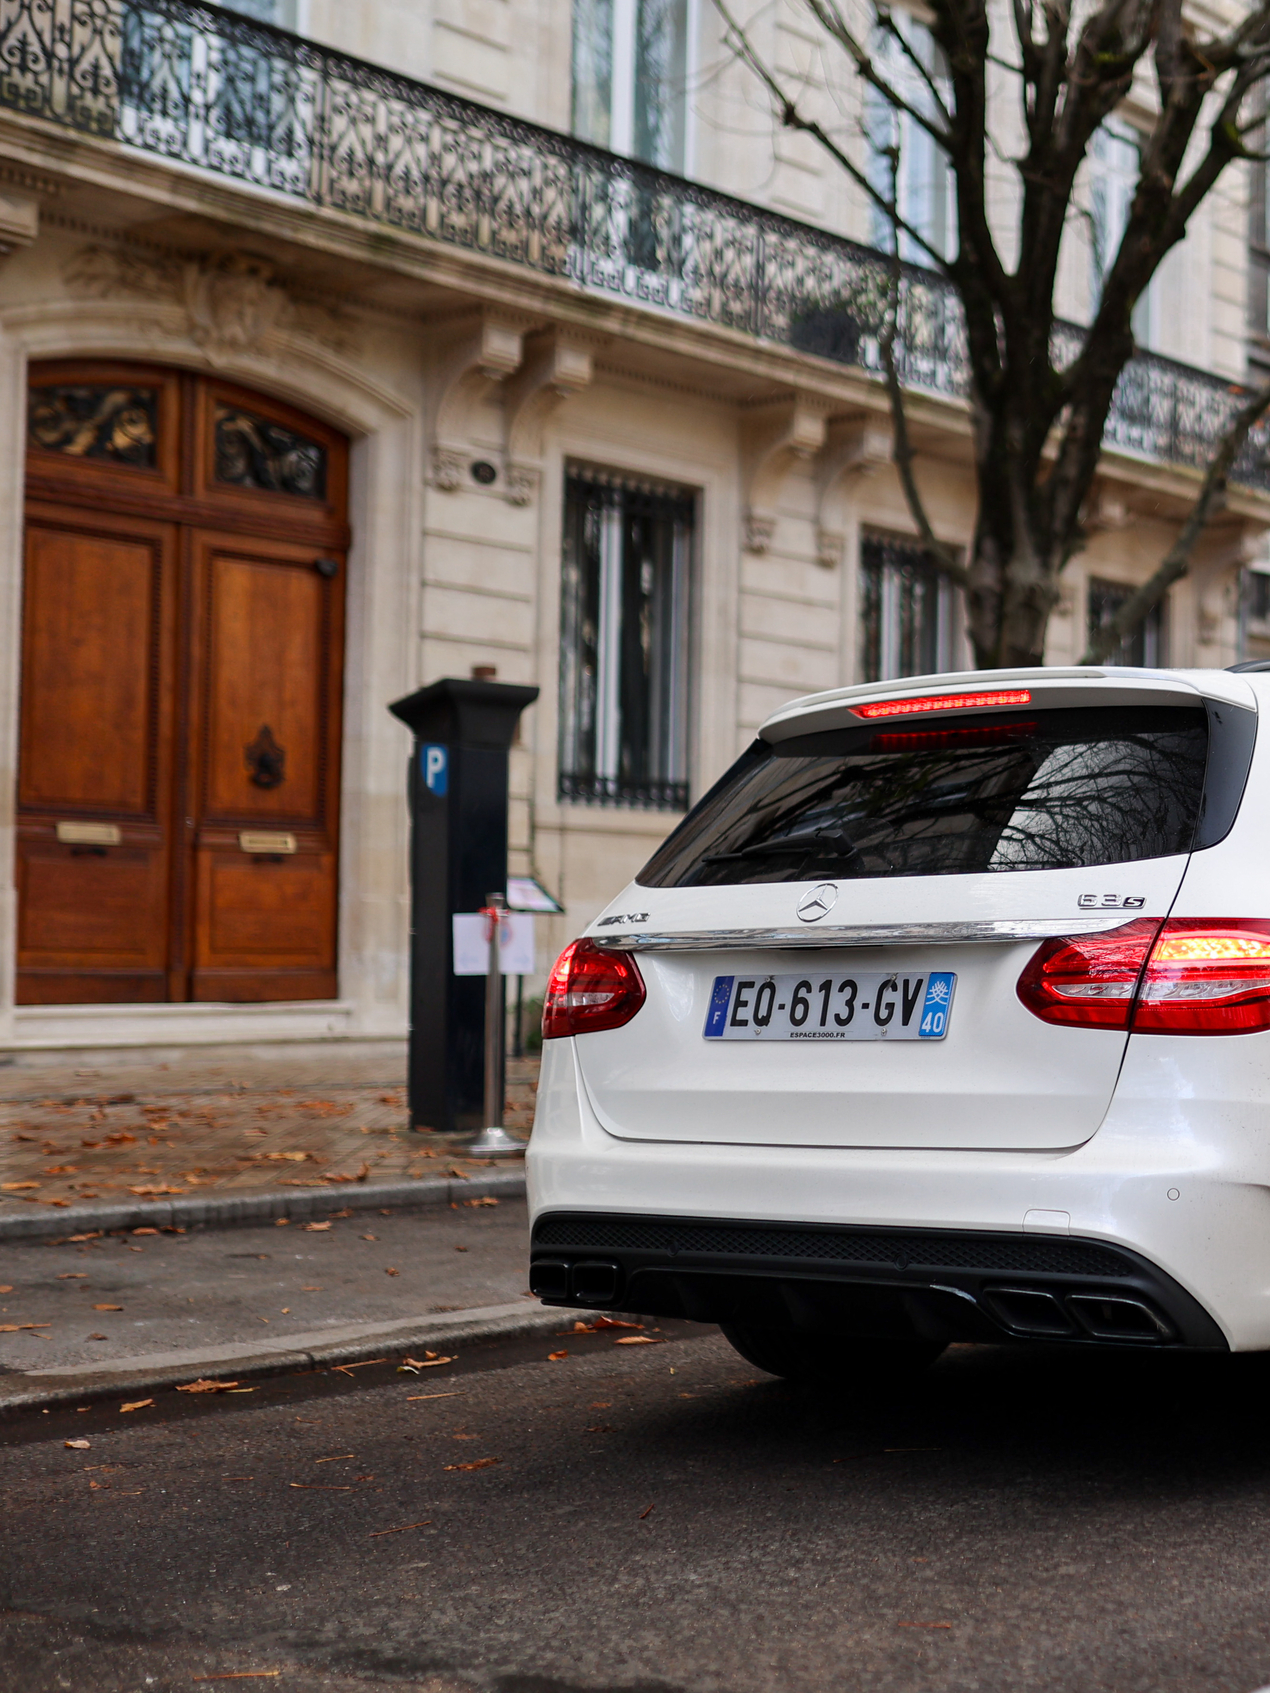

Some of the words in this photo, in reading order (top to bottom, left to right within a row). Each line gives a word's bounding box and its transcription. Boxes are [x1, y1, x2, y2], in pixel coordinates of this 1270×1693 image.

[426, 746, 446, 788] P
[712, 1011, 721, 1025] F
[730, 978, 924, 1027] EQ-613-GV
[921, 1012, 944, 1033] 40
